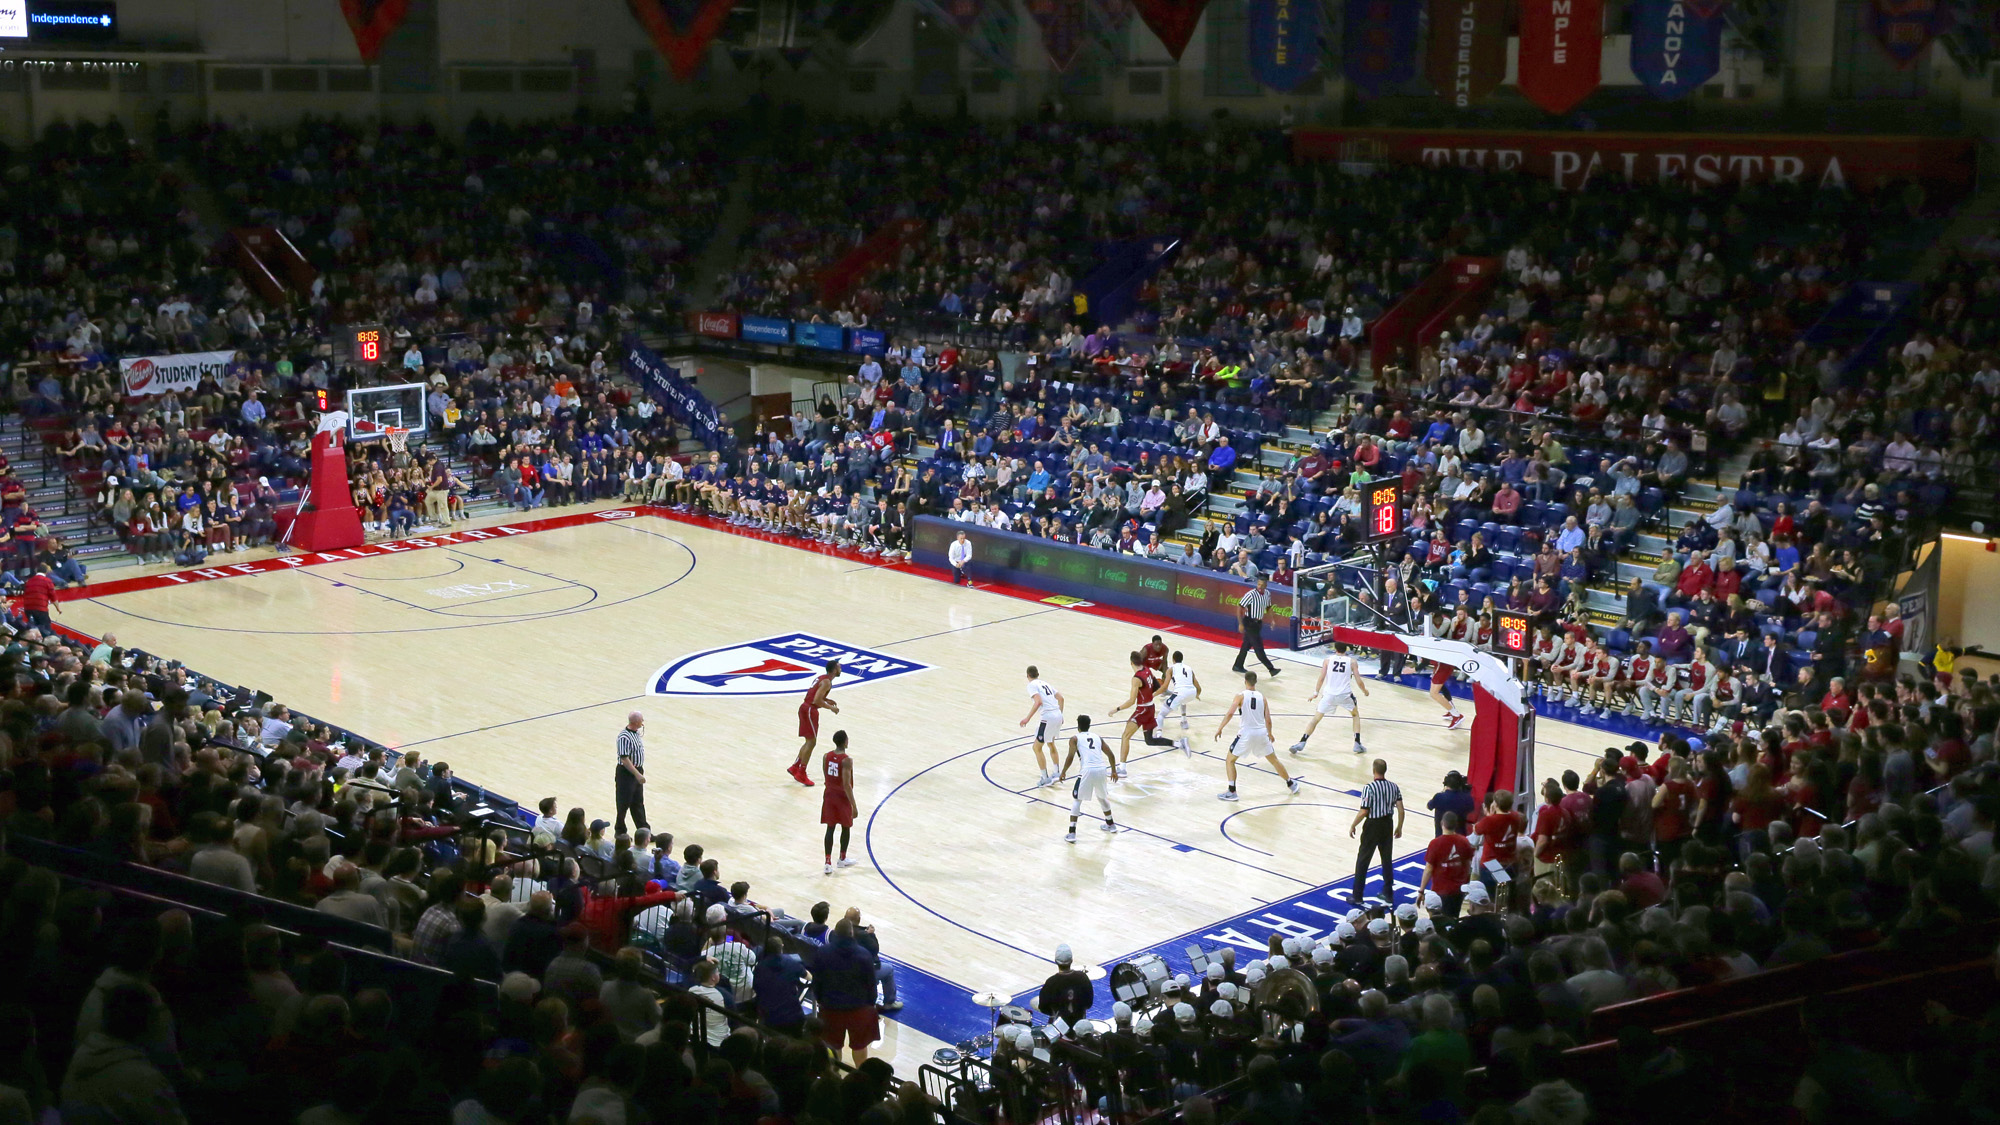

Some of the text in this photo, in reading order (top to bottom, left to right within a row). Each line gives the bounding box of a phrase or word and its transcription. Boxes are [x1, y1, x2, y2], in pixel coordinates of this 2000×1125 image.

[31, 13, 99, 25] Independence
[1455, 2, 1475, 107] JOSEPHS
[82, 61, 140, 73] FAMILY
[704, 317, 729, 333] Coca-Cola
[743, 323, 780, 334] Independence
[357, 331, 379, 342] 18:05
[363, 341, 378, 360] 18
[629, 348, 651, 374] PENN
[155, 365, 197, 384] STUDENT
[1373, 487, 1396, 505] 18:05
[1379, 506, 1394, 533] 18
[157, 524, 529, 584] THE PALESTRA
[1144, 578, 1168, 592] Coca-Cola
[1182, 585, 1207, 600] Coca-Cola
[1501, 616, 1527, 632] 18:05
[1508, 632, 1522, 649] 18
[769, 637, 909, 674] PENN
[1182, 667, 1188, 678] 4
[1332, 661, 1346, 673] 25
[1042, 684, 1053, 696] 21
[1250, 697, 1257, 710] 0
[1087, 738, 1096, 750] 2
[827, 761, 839, 777] 25
